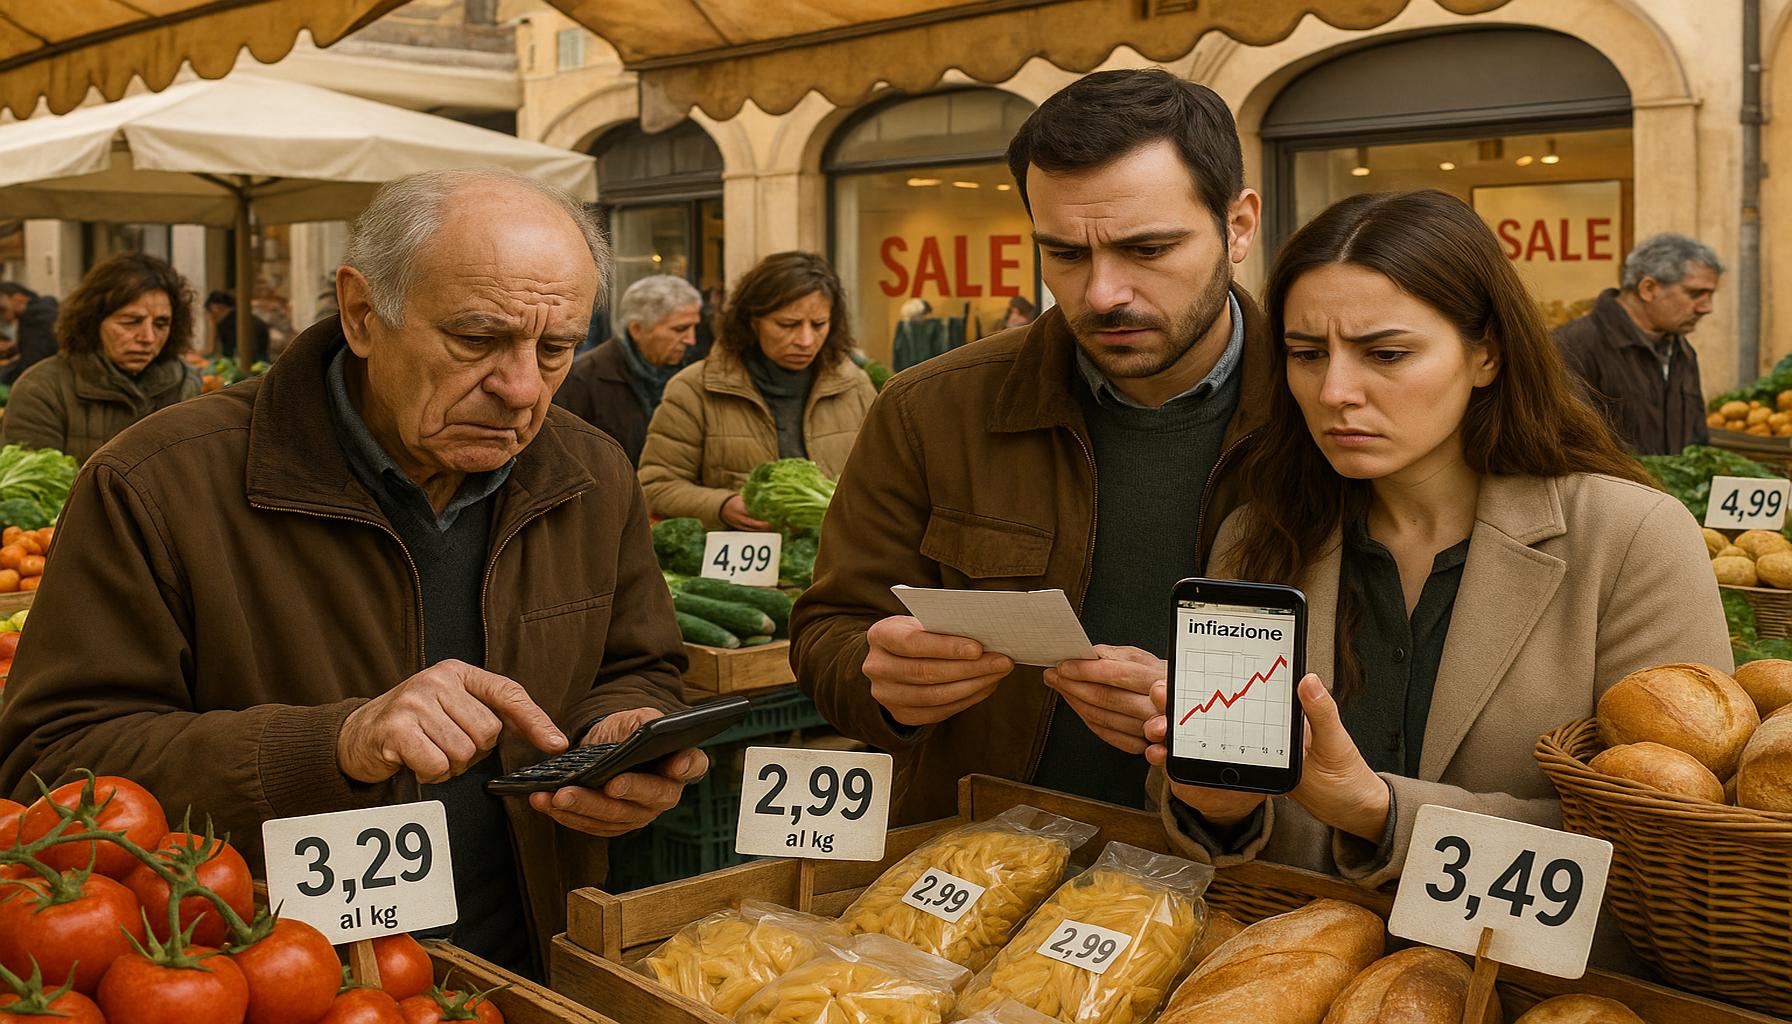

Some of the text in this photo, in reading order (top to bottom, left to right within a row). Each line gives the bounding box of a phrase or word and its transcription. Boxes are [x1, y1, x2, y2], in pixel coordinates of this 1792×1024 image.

[1497, 218, 1612, 262] SALE
[880, 233, 1022, 298] SALE
[1720, 488, 1782, 522] 4,99
[712, 544, 772, 577] 4,99
[755, 764, 873, 826] 2,99
[785, 829, 835, 854] al kg
[295, 822, 433, 904] 3,29
[1425, 835, 1584, 927] 3,49
[911, 876, 972, 913] 2,99
[340, 902, 399, 930] al kg
[1050, 927, 1117, 965] 2,99
